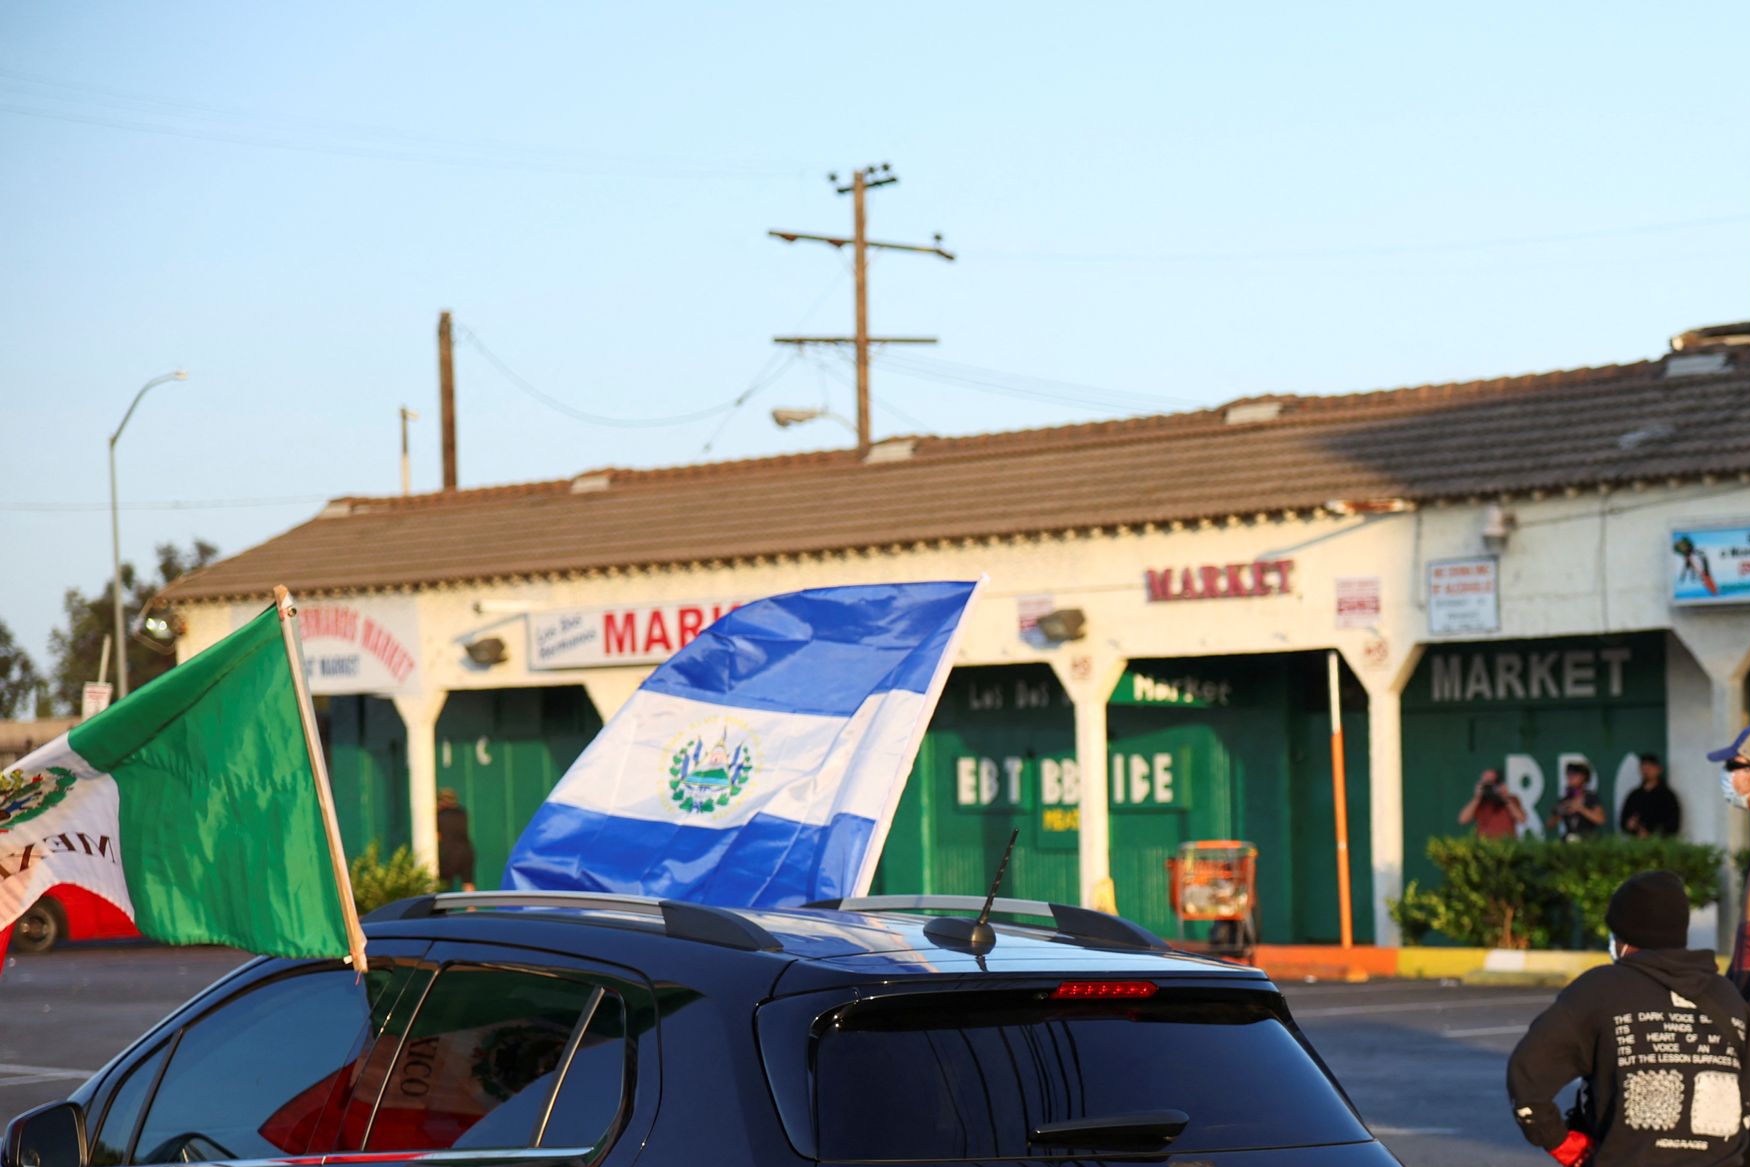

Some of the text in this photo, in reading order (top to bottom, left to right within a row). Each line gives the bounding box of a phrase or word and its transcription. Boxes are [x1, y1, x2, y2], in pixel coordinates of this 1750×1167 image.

[1144, 560, 1294, 602] MARKET
[603, 600, 743, 657] MAR
[1432, 650, 1632, 701] MARKET
[956, 756, 1024, 805] EBT
[1614, 1013, 1633, 1025] THE
[1638, 1011, 1664, 1021] DARK
[1669, 1012, 1695, 1024] VOICE
[1615, 1022, 1693, 1035] ITS HANDS
[1616, 1032, 1721, 1045] THE HEART OF MY
[1617, 1046, 1632, 1056] ITS
[1652, 1043, 1680, 1053] VOICE
[1617, 1056, 1636, 1067] BUT
[1637, 1053, 1656, 1064] THE
[1658, 1054, 1691, 1064] LESSON
[1692, 1055, 1732, 1066] SURFACES
